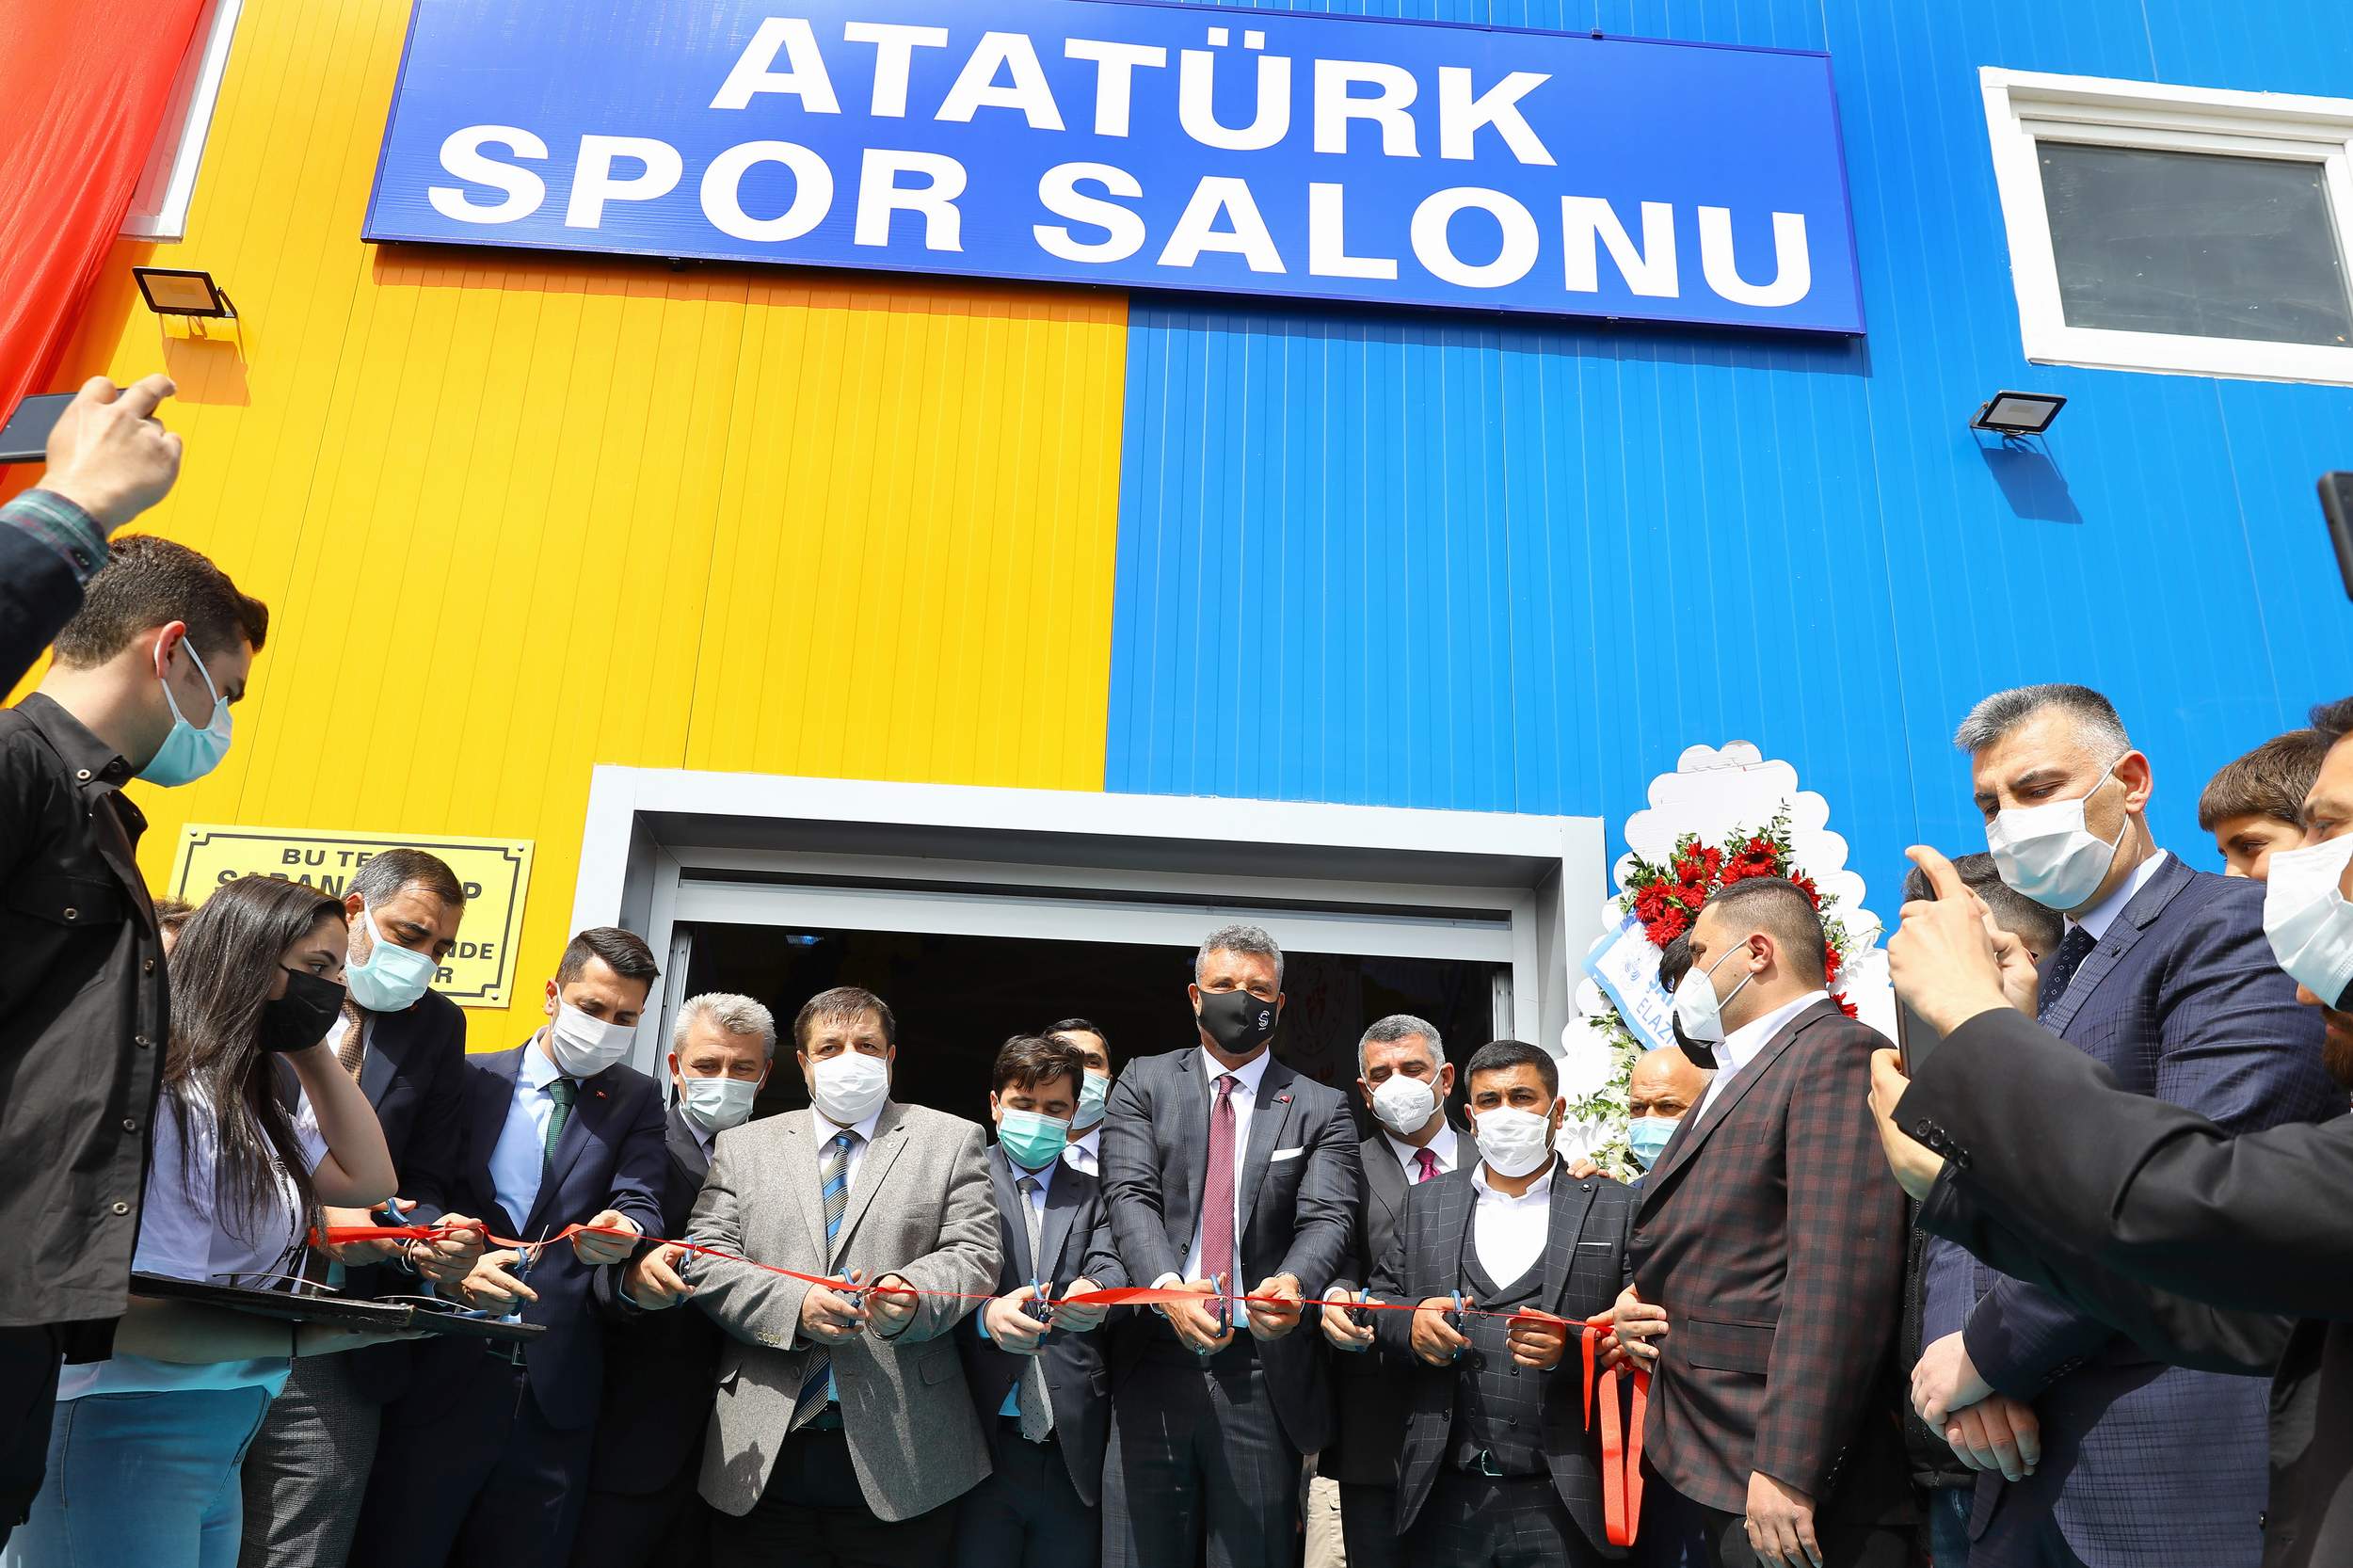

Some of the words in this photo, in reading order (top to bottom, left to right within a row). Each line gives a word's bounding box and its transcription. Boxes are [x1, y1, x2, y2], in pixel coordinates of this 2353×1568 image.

[710, 16, 1559, 167] ATATÜRK
[426, 124, 968, 252] SPOR
[1032, 161, 1812, 308] SALONU
[282, 848, 326, 866] BU
